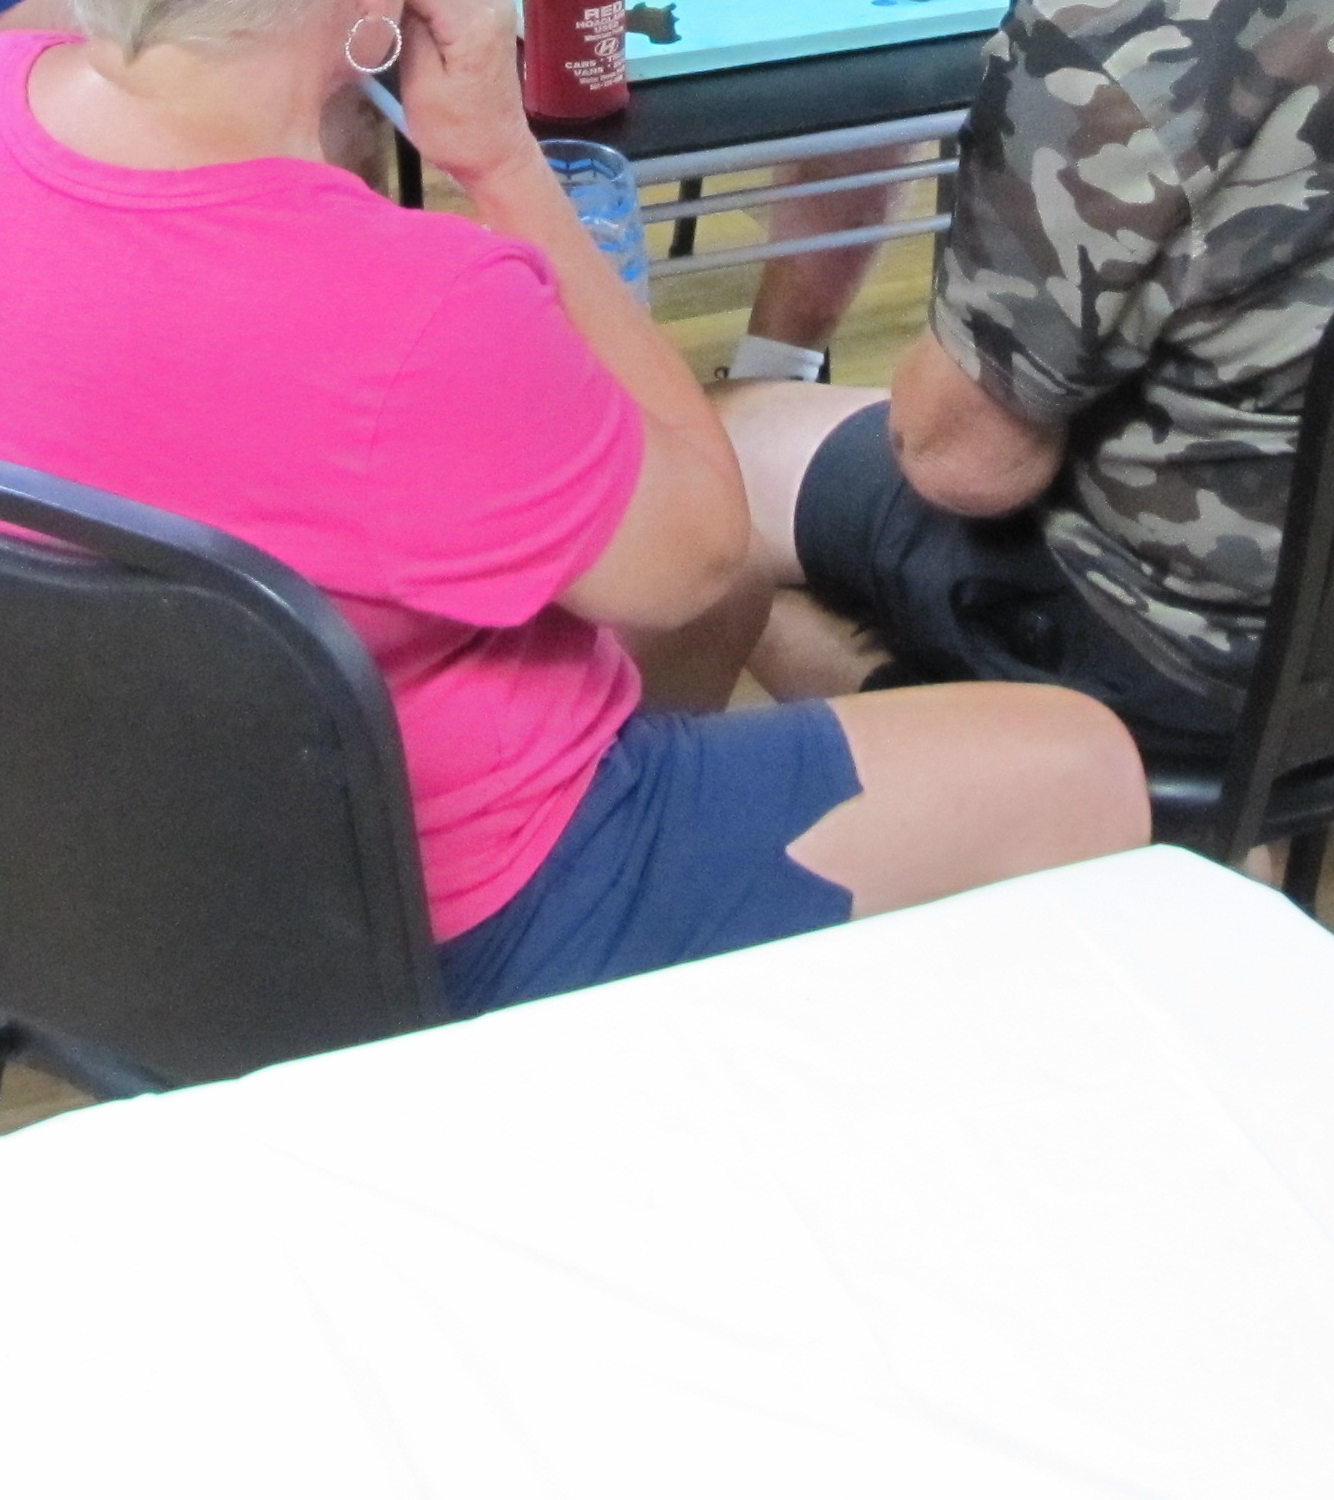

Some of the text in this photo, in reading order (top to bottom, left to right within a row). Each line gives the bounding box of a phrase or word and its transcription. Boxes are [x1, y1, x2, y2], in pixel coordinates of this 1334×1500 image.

[584, 0, 623, 20] RED
[564, 59, 597, 69] CARS
[574, 66, 604, 77] VANS
